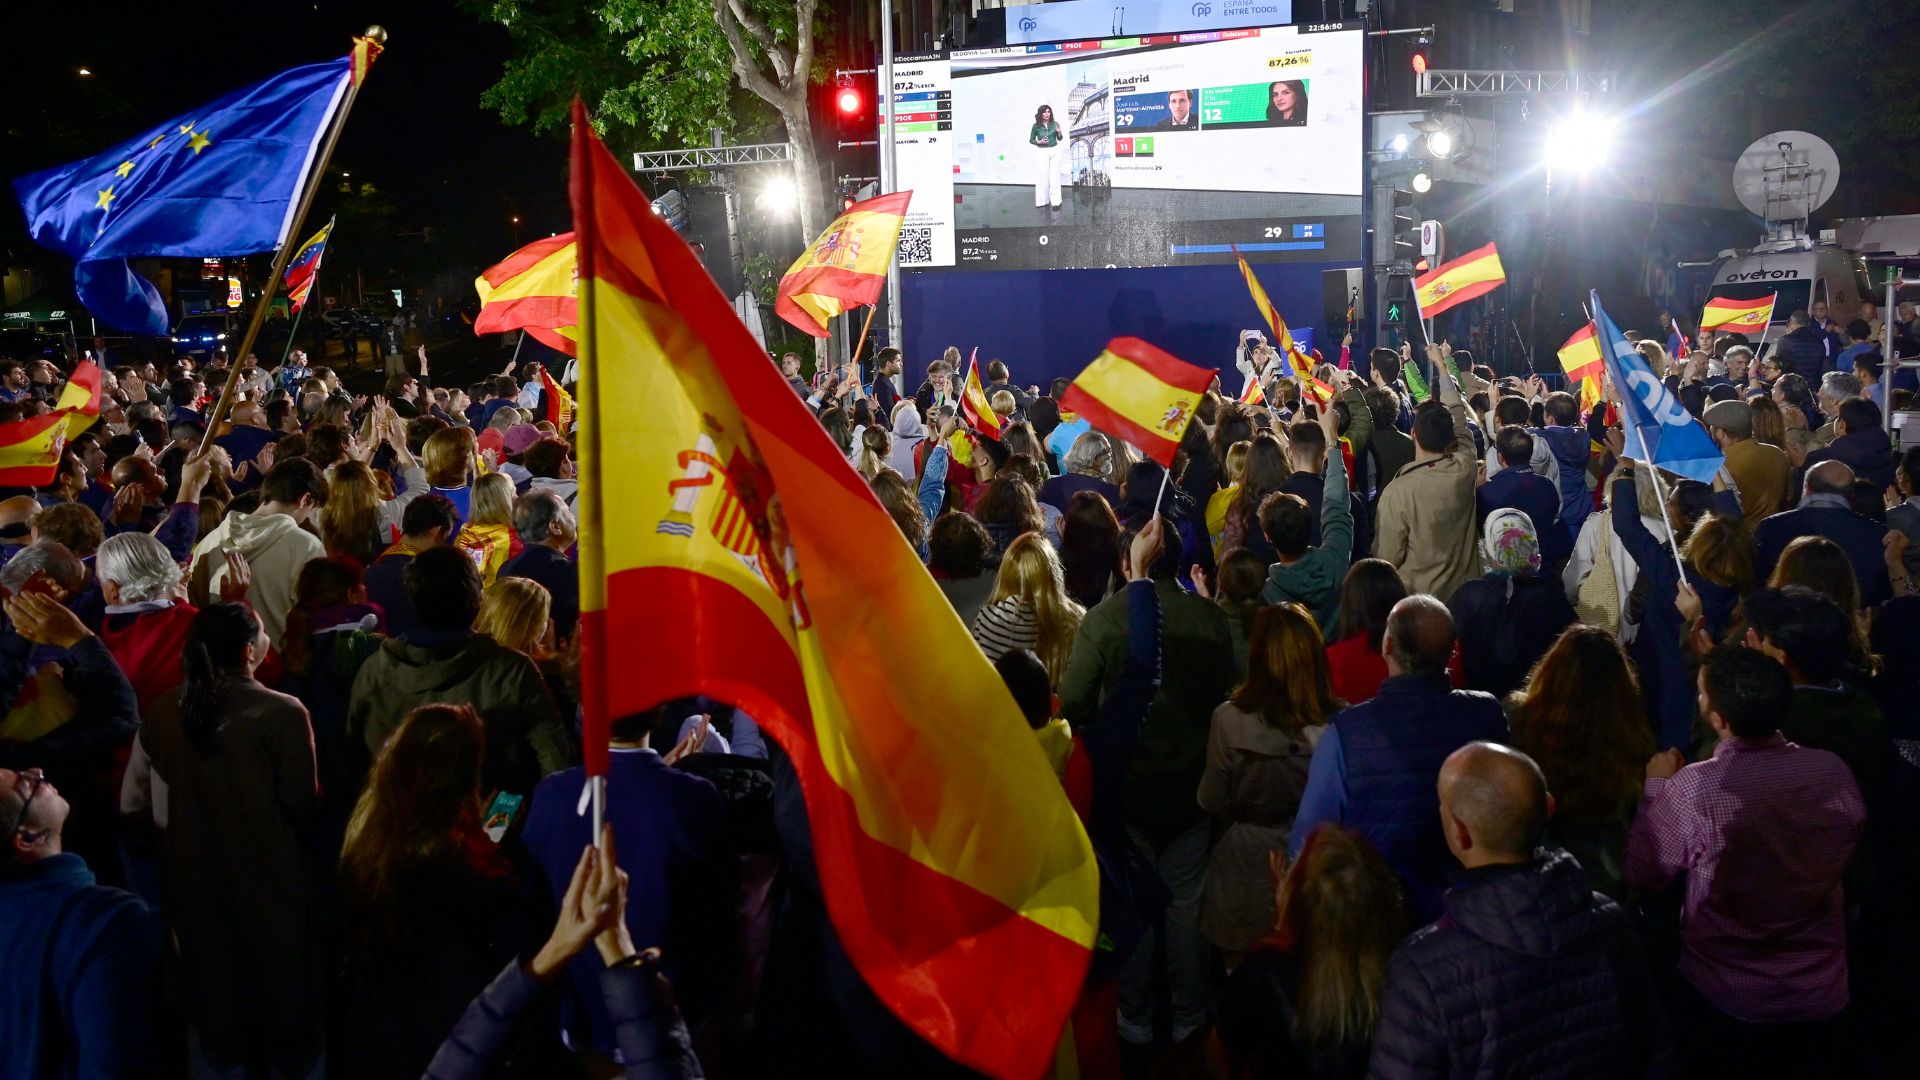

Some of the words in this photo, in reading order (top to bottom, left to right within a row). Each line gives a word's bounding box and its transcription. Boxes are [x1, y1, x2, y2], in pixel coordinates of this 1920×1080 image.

[1223, 8, 1250, 16] ENTRE
[1251, 6, 1278, 14] TODOS
[1308, 23, 1343, 32] 22:56:50
[1268, 57, 1298, 67] 87,26
[1299, 55, 1309, 64] %
[1113, 74, 1150, 86] Madrid
[894, 81, 914, 92] 87,2
[895, 114, 912, 122] PSOE
[1116, 114, 1134, 126] 29
[1203, 108, 1223, 122] 12
[1120, 143, 1128, 151] 11
[1264, 226, 1282, 238] 29
[961, 236, 990, 244] MADRID
[1039, 235, 1049, 245] 0
[962, 248, 979, 256] 87,2
[1726, 268, 1798, 283] overon
